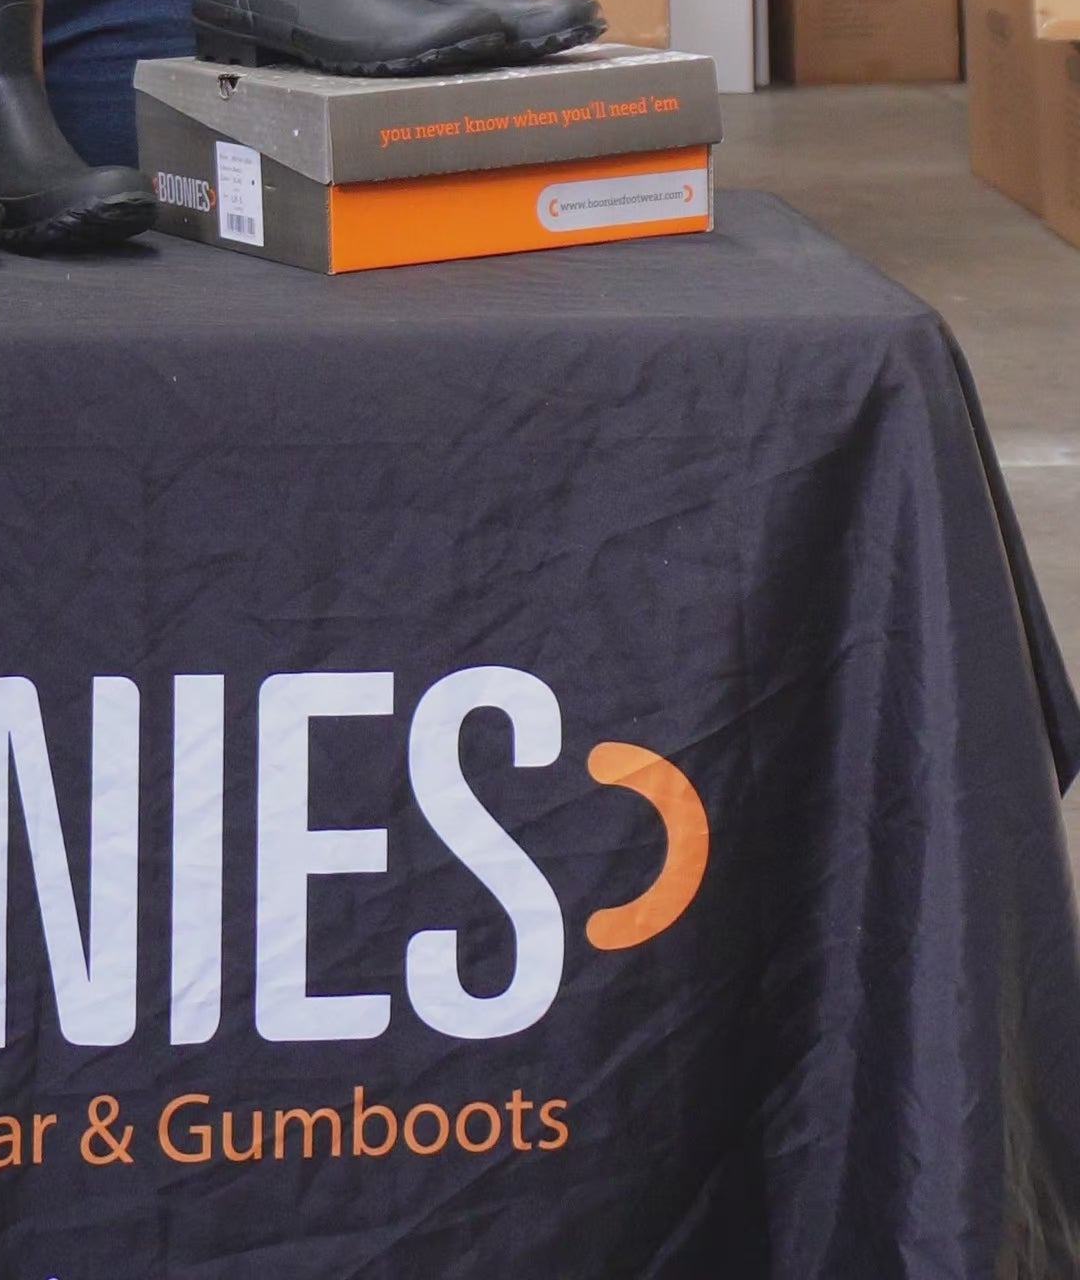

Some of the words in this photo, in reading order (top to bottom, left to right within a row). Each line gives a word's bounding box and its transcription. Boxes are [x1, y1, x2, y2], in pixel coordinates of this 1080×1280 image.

[380, 126, 412, 148] you
[415, 121, 460, 138] never
[464, 116, 509, 134] know
[512, 109, 558, 128] when
[561, 102, 606, 127] you'll
[609, 97, 647, 116] need
[650, 96, 679, 112] 'em
[158, 171, 211, 212] BOONIES
[79, 1093, 136, 1166] &
[158, 1085, 570, 1165] Gumboots
